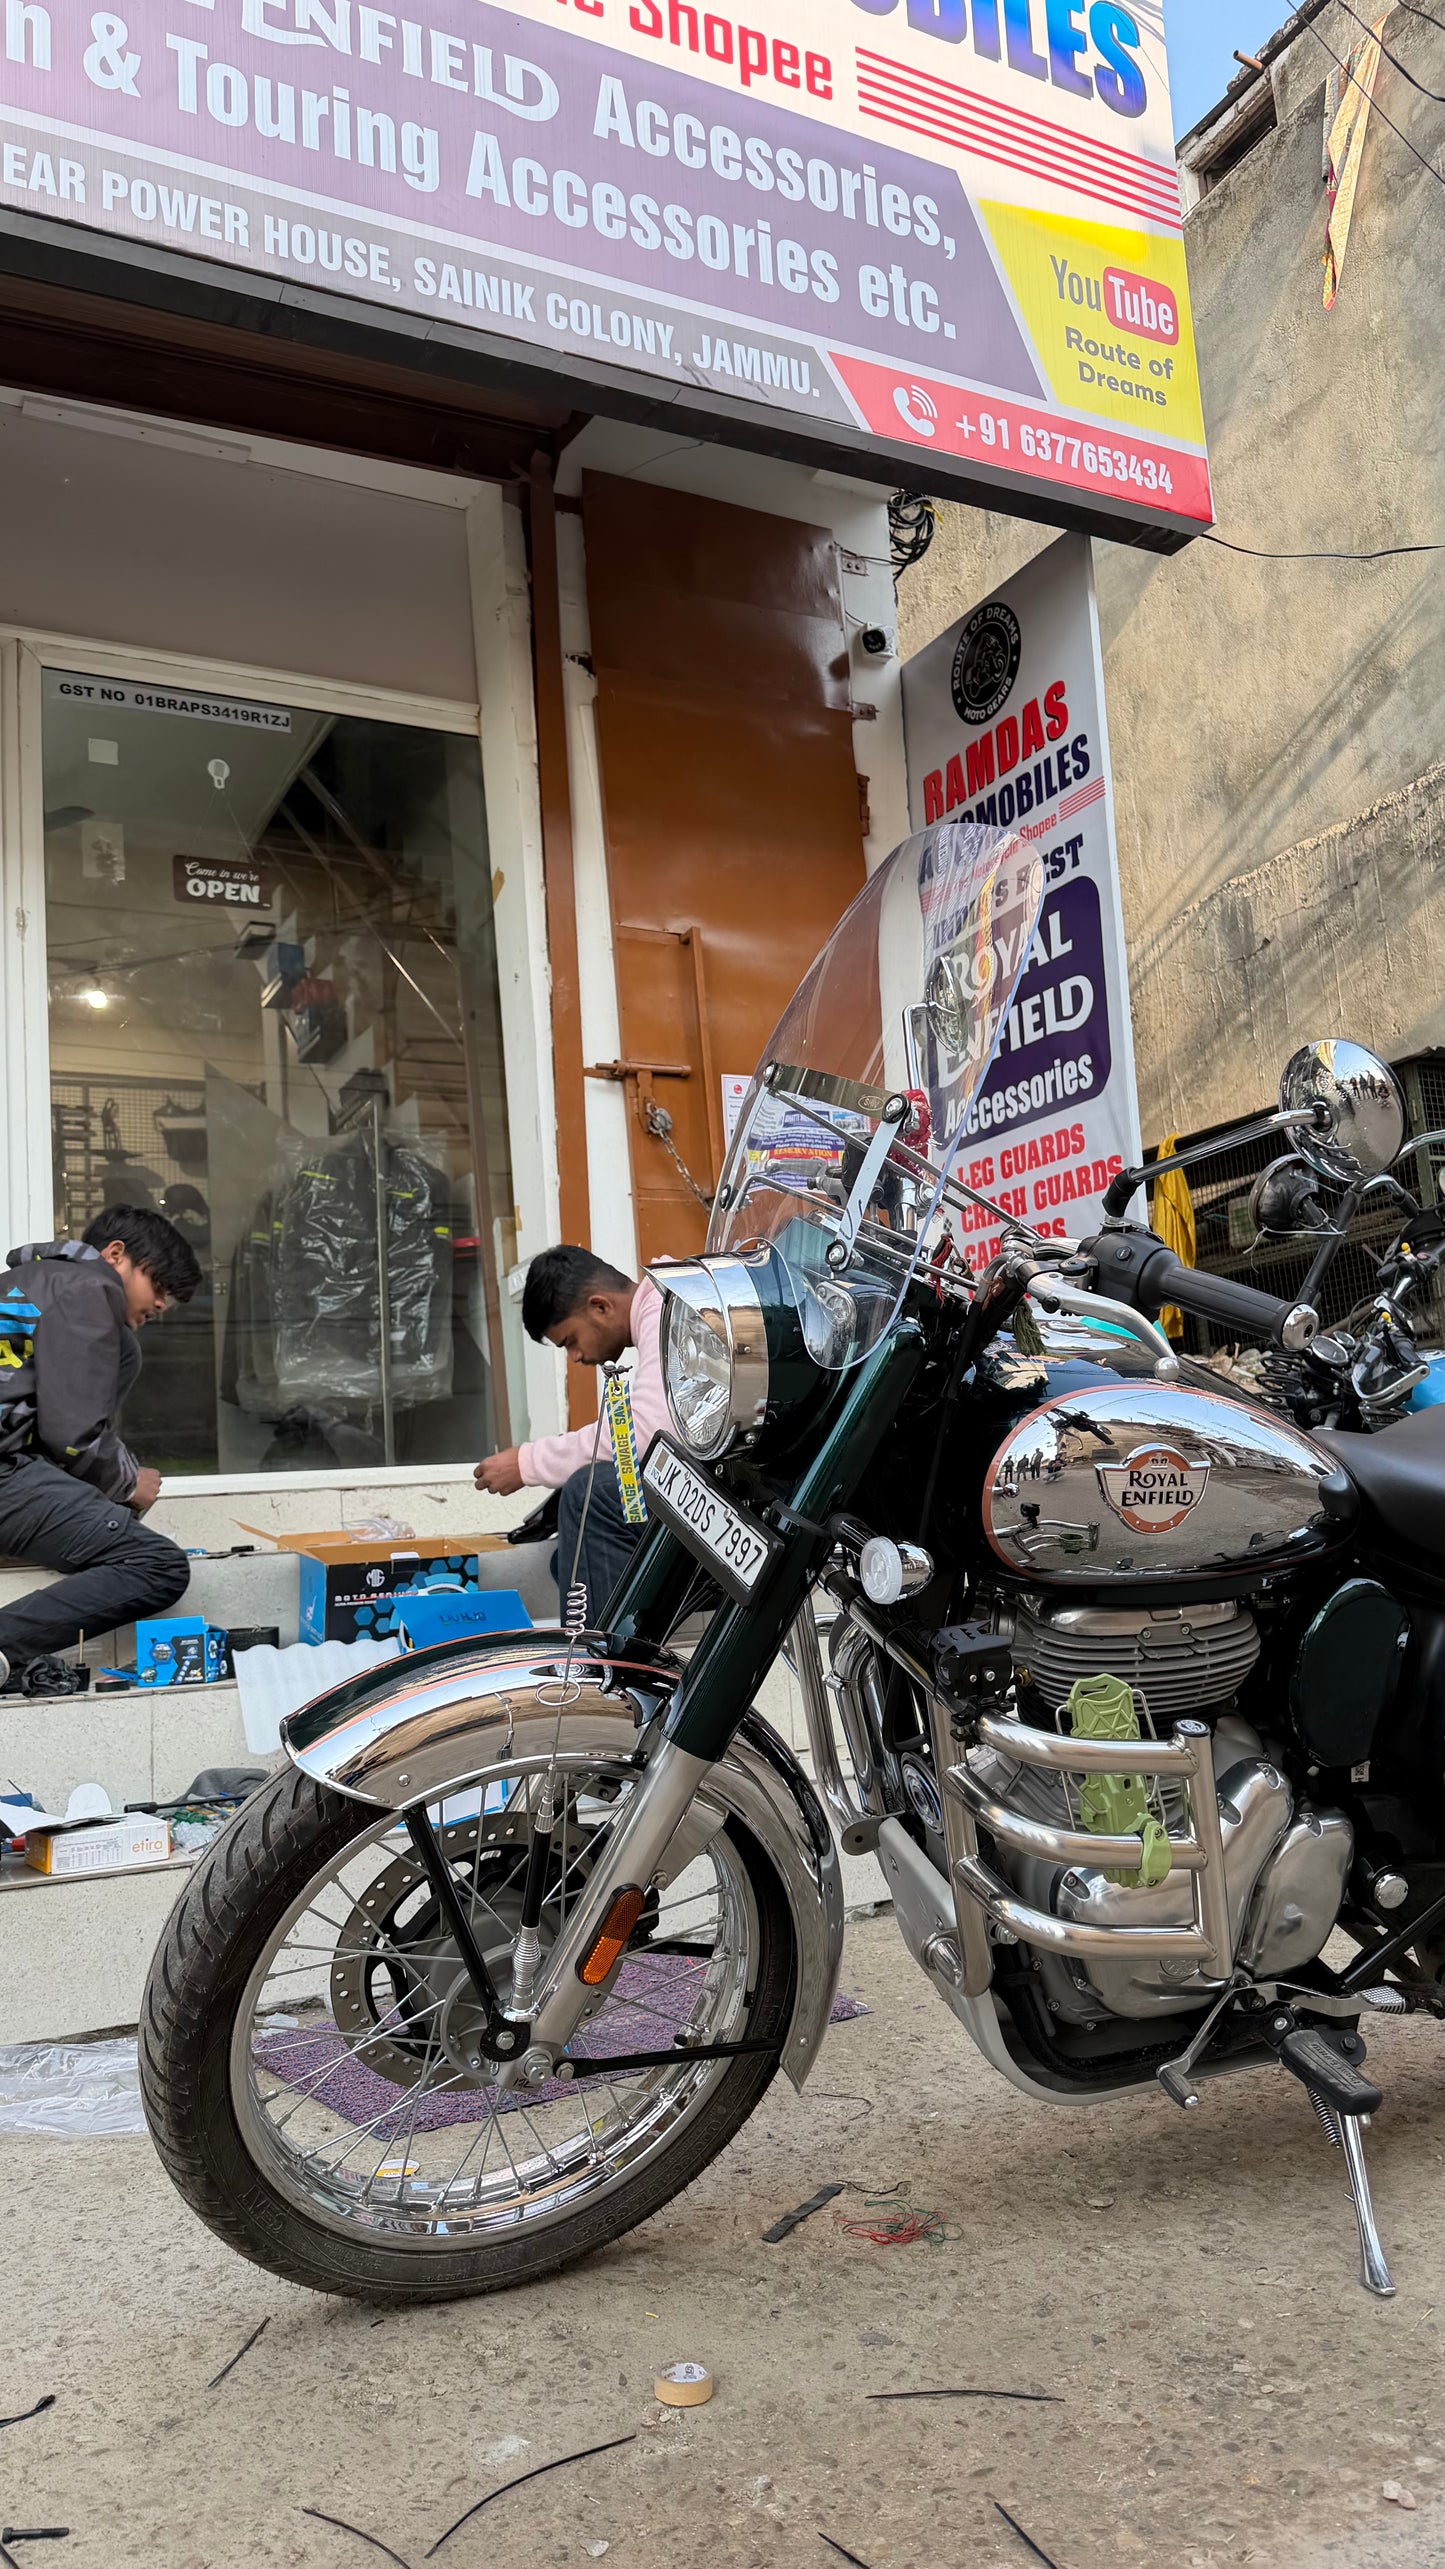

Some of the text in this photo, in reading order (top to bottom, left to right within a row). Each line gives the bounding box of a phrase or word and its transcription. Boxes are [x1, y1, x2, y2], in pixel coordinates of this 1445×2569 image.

[629, 0, 833, 101] Shopee
[241, 0, 957, 260] ENFIELD Accessories,
[84, 11, 141, 98] &
[166, 33, 441, 192] Touring
[465, 130, 839, 303] Accessories
[858, 265, 957, 339] etc.
[3, 142, 820, 397] EAR POWER HOUSE, SAINIK COLONY, JAMMU.
[1065, 325, 1174, 380] Route of
[1078, 361, 1167, 406] Dreams
[956, 414, 1174, 494] +91 6377653434
[953, 606, 1019, 691] ROUTE OF DREAMS
[59, 683, 290, 728] GST NO 01BRAPS3419R1ZJ
[964, 676, 1013, 720] MOTO GEARS
[922, 680, 1069, 826] RAMDAS
[1020, 813, 1057, 842] Shopee
[185, 862, 217, 876] Come
[219, 869, 231, 879] in
[186, 878, 260, 904] OPEN
[950, 910, 1073, 1006] ROYAL
[943, 1053, 1094, 1139] Accessories
[1000, 1124, 1086, 1180] GUARDS
[1033, 1155, 1123, 1211] GUARDS
[616, 1433, 633, 1474] SAVAGE
[1129, 1471, 1188, 1488] ROYAL
[657, 1462, 682, 1496] JK
[714, 1515, 763, 1574] 7997
[1121, 1490, 1194, 1507] ENFIELD
